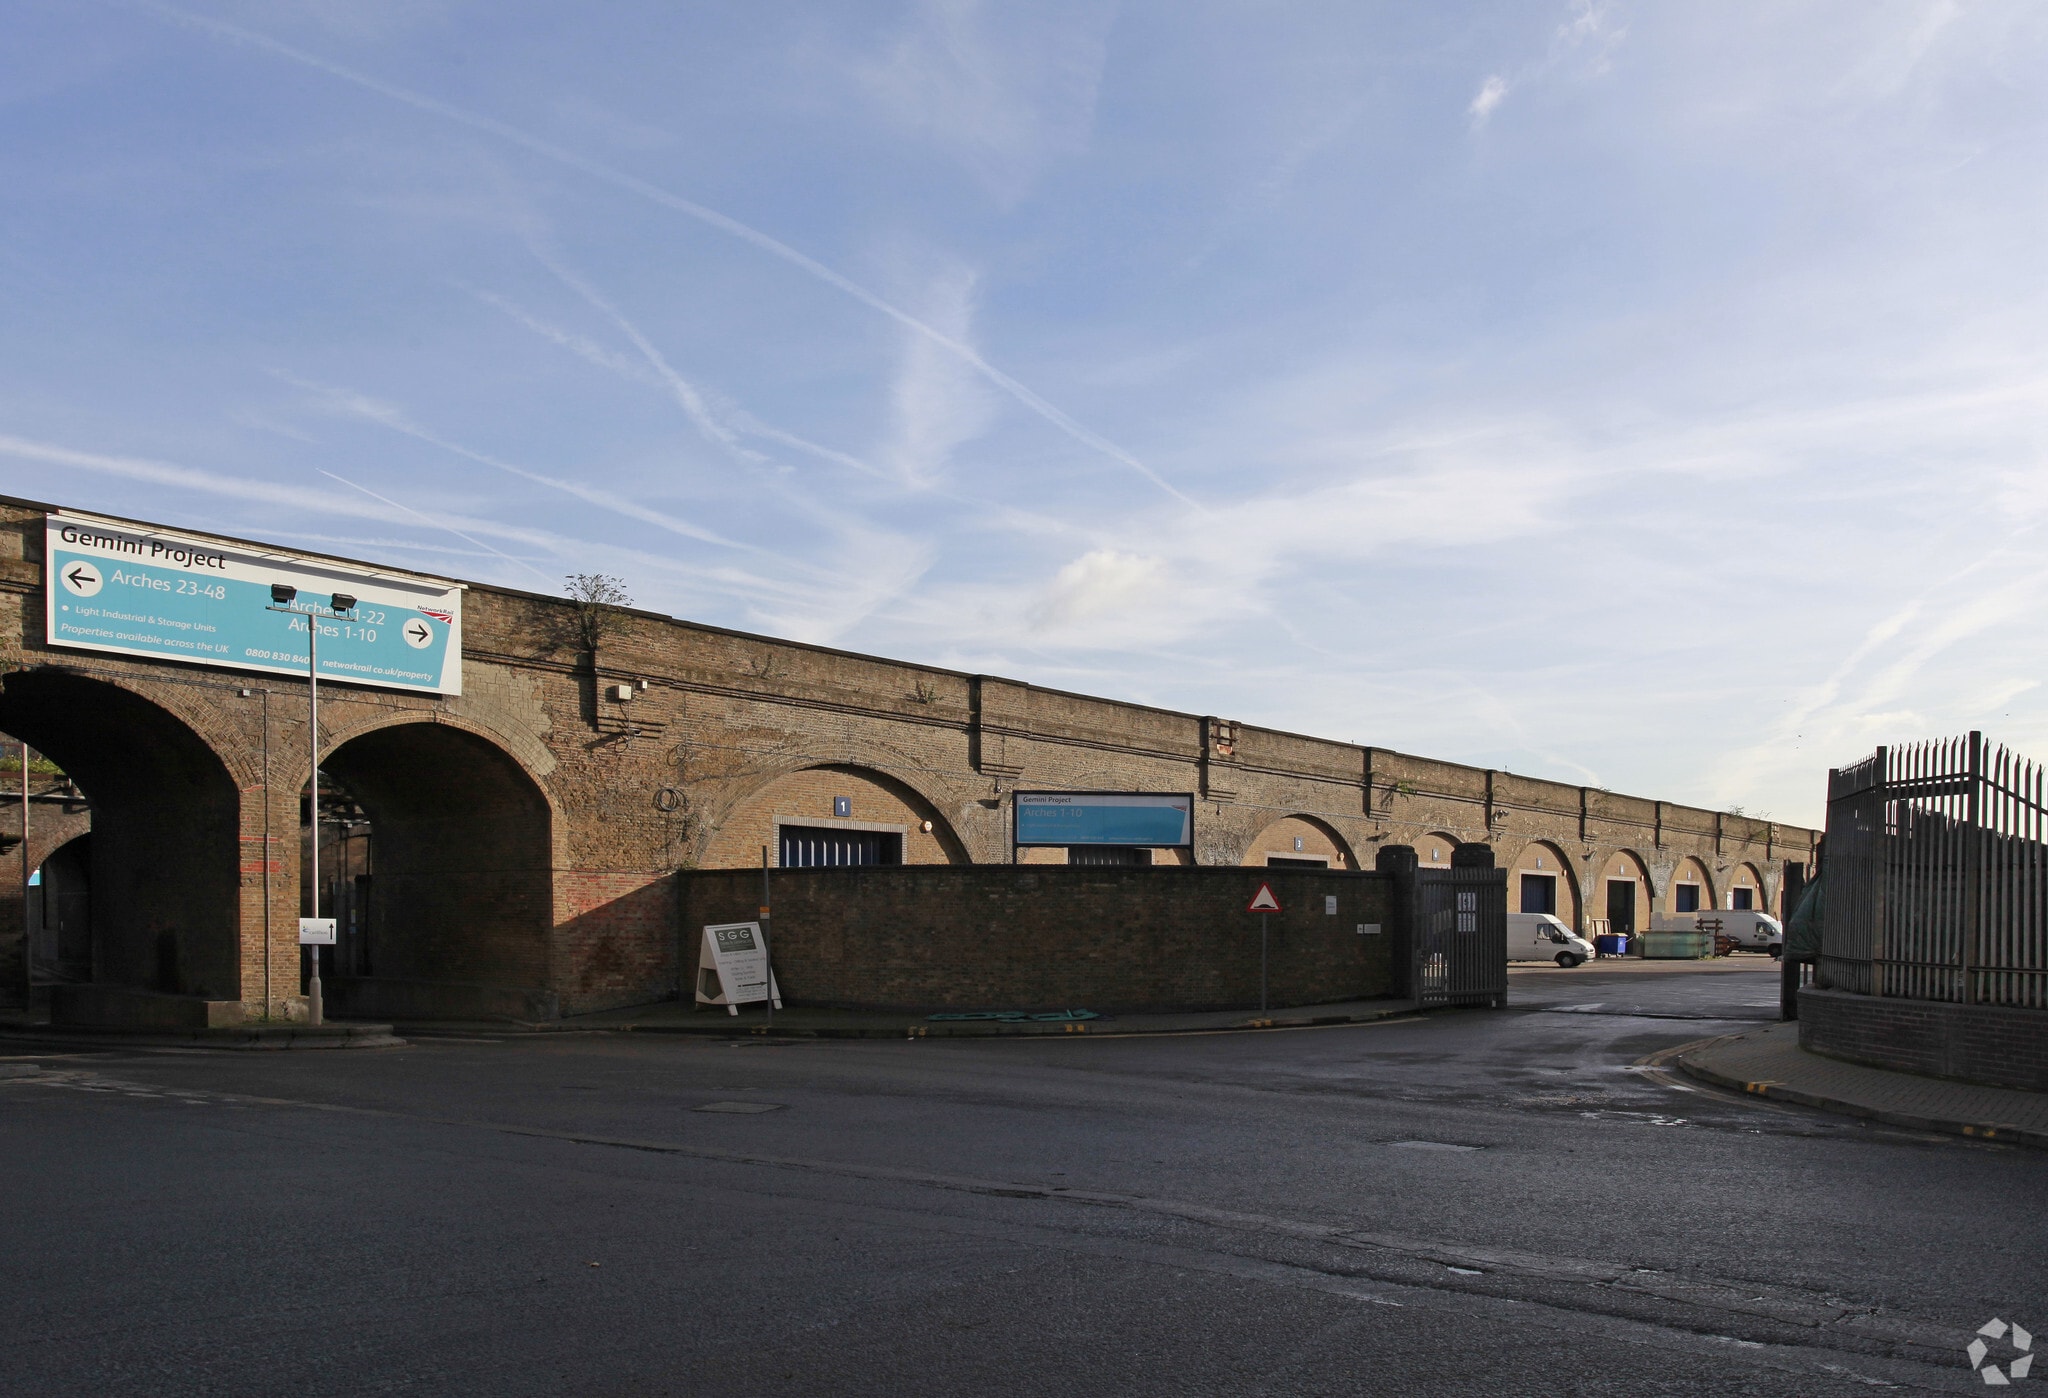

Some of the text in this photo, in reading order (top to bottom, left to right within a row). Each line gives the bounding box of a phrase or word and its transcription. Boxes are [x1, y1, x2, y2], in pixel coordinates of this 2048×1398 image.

[60, 526, 227, 570] Gemini Project
[111, 569, 226, 600] Arches 23-48
[75, 605, 217, 633] Light Industrial & Storage Units
[290, 598, 385, 625] Arche 1-22
[60, 623, 230, 654] Properties available across the UK
[344, 626, 377, 643] 1-10
[245, 648, 310, 665] 0800 830 840
[840, 801, 846, 812] 1
[1048, 796, 1071, 804] Project
[1023, 807, 1083, 818] Arches 1-10
